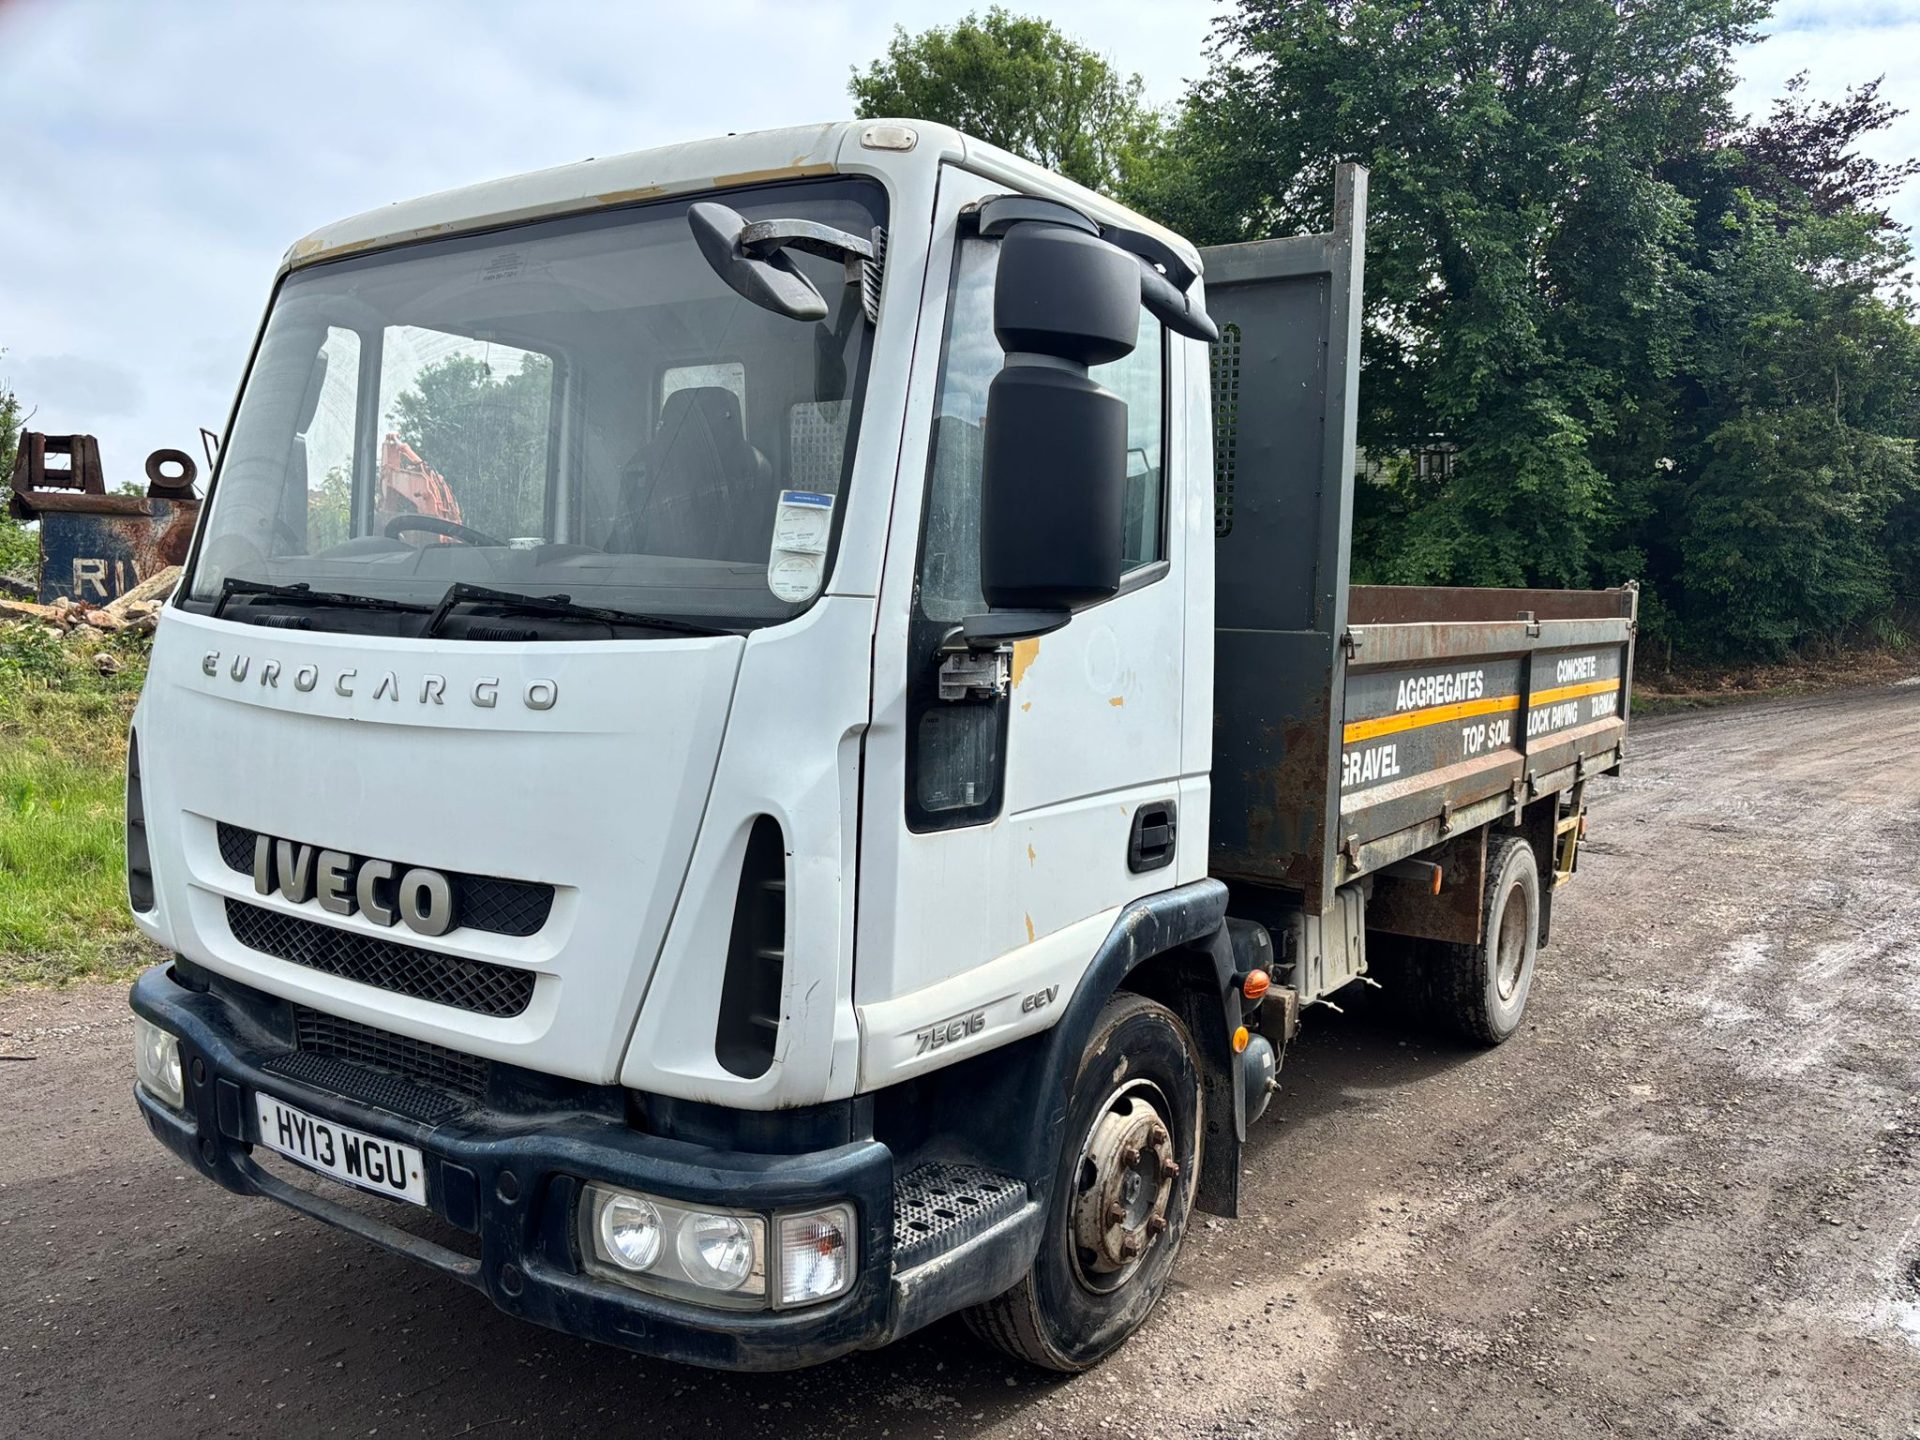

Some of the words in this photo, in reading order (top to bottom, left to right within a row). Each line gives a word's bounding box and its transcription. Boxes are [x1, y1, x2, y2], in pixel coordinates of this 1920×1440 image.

[202, 650, 558, 711] EUROCARGO
[1396, 670, 1483, 711] AGGREGATES
[1556, 656, 1596, 683] CONCRETE
[1462, 724, 1486, 755] TOP
[1488, 719, 1511, 747] SOIL
[1526, 708, 1550, 737] LOCK
[1551, 701, 1578, 730] PAVING
[1341, 744, 1400, 788] GRAVEL
[254, 835, 454, 936] IVECO
[915, 1011, 986, 1057] 75E16
[1022, 984, 1060, 1014] EEV
[276, 1106, 336, 1167] HY13
[342, 1133, 407, 1190] WGU
